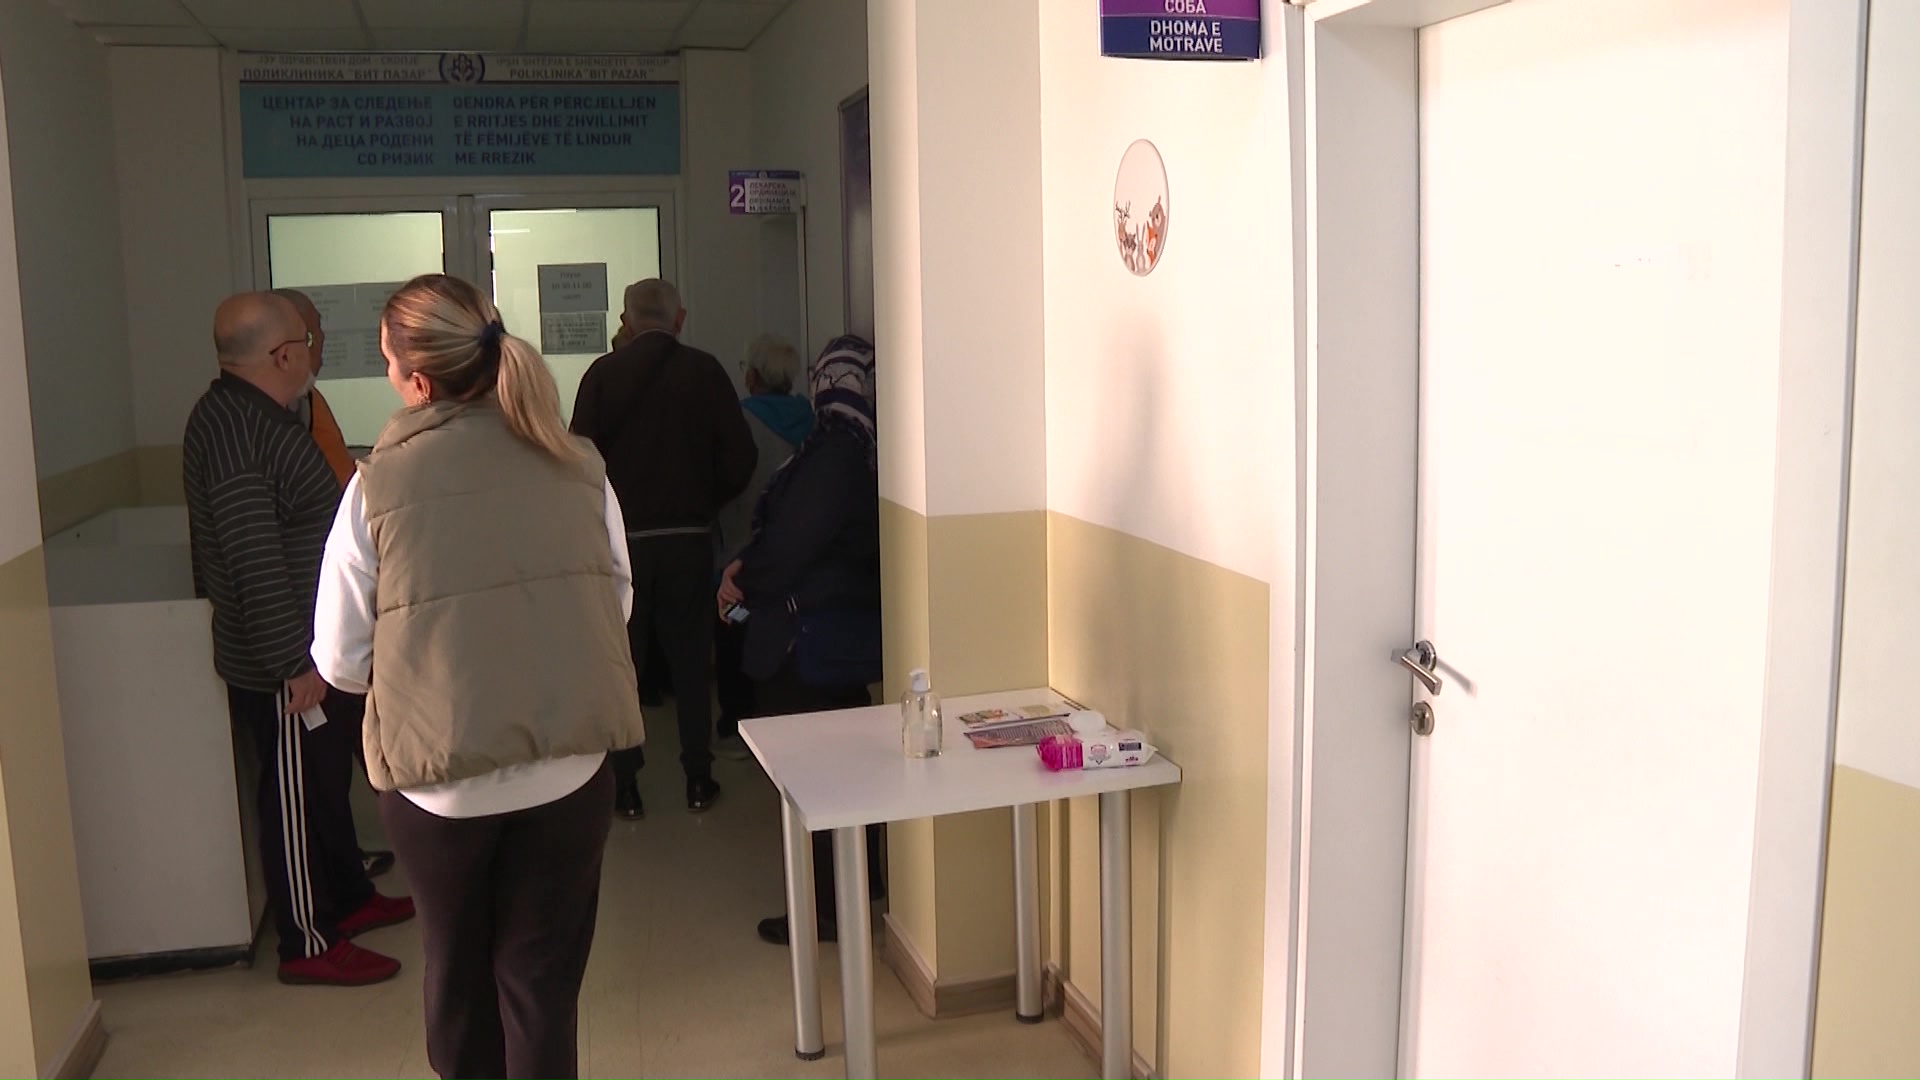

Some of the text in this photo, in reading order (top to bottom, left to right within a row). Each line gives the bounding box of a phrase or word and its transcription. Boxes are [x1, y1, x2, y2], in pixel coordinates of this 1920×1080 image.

[1164, 0, 1207, 14] СОБА
[1150, 20, 1222, 36] DHOMA E
[1150, 37, 1223, 52] MOTRAVE
[349, 55, 372, 66] ДОМ
[243, 69, 345, 80] ПОЛИКЛИНИКА
[510, 69, 583, 80] POLIKLINIKA
[262, 96, 433, 111] ЦЕНТАР ЗА СЛЕДЕЊЕ
[453, 96, 516, 109] QENDRA
[290, 115, 432, 128] НА РАСТ И РАЗВОЈ
[454, 115, 648, 128] E RRITJES DHE ZHVILLIMIT
[296, 134, 433, 149] НА ДЕЦА РОДЕНИ
[455, 130, 633, 146] TË FËMIJËVE TË LINDUR
[357, 152, 433, 166] СО РИЗИК
[455, 152, 536, 166] ME RREZIK
[730, 184, 745, 208] 2
